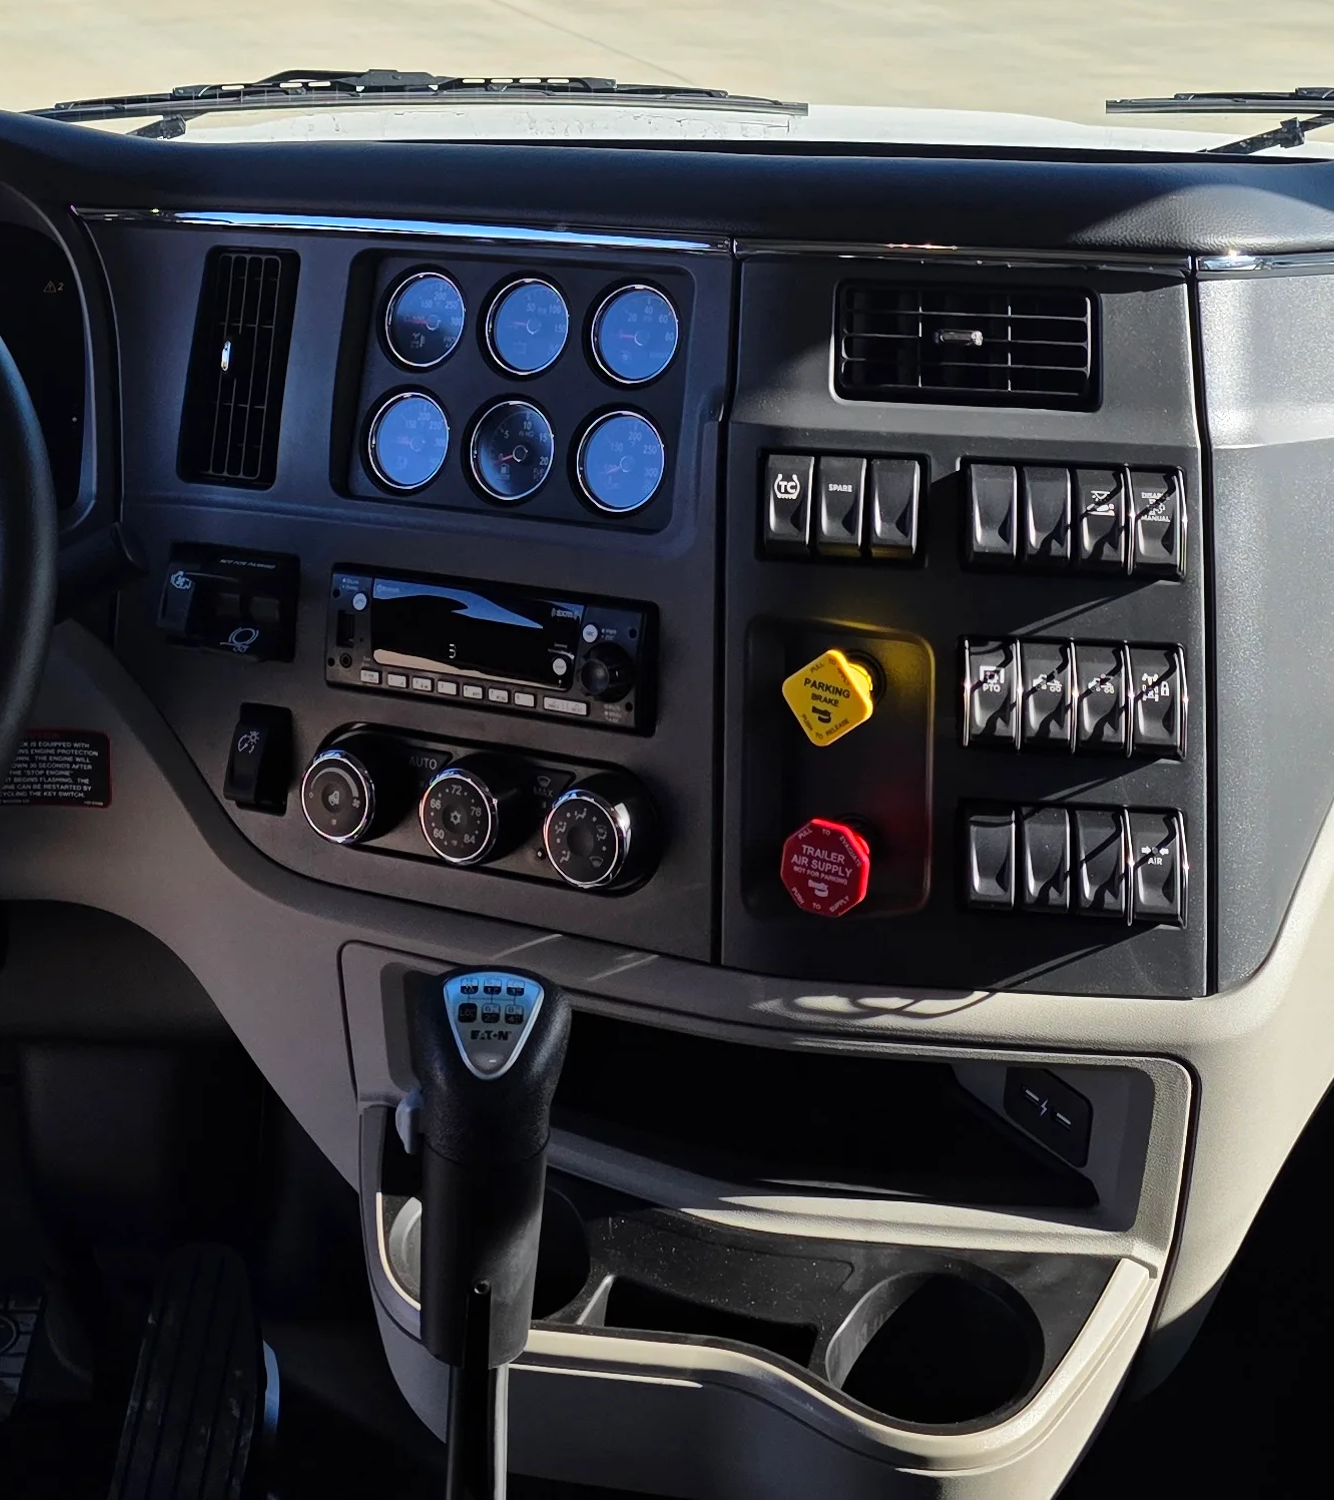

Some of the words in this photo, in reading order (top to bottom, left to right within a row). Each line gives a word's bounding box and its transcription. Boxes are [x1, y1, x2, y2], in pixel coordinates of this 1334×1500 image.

[57, 282, 65, 291] 2
[523, 421, 532, 430] 10
[503, 430, 510, 439] 5
[539, 456, 549, 466] 20
[778, 481, 796, 493] TC
[828, 484, 853, 493] SPARE
[1141, 515, 1171, 523] MANUAL
[809, 662, 824, 673] PULL
[803, 677, 851, 699] PARKING
[982, 683, 1001, 692] PTO
[811, 693, 840, 707] BRAKE
[815, 732, 824, 740] TO
[825, 718, 850, 736] RELEASE
[408, 756, 438, 771] AUTO
[450, 784, 463, 795] 72
[533, 786, 554, 799] MAX
[430, 799, 442, 810] 66
[470, 806, 482, 817] 78
[433, 829, 445, 840] 60
[822, 828, 831, 836] TO
[463, 834, 476, 844] 84
[801, 844, 845, 865] TRAILER
[791, 854, 809, 866] AIR
[810, 859, 853, 878] SUPPLY
[1147, 857, 1163, 866] AIR
[793, 865, 806, 873] NOT
[806, 869, 820, 878] FOR
[820, 873, 848, 885] PARKING
[812, 902, 822, 910] TO
